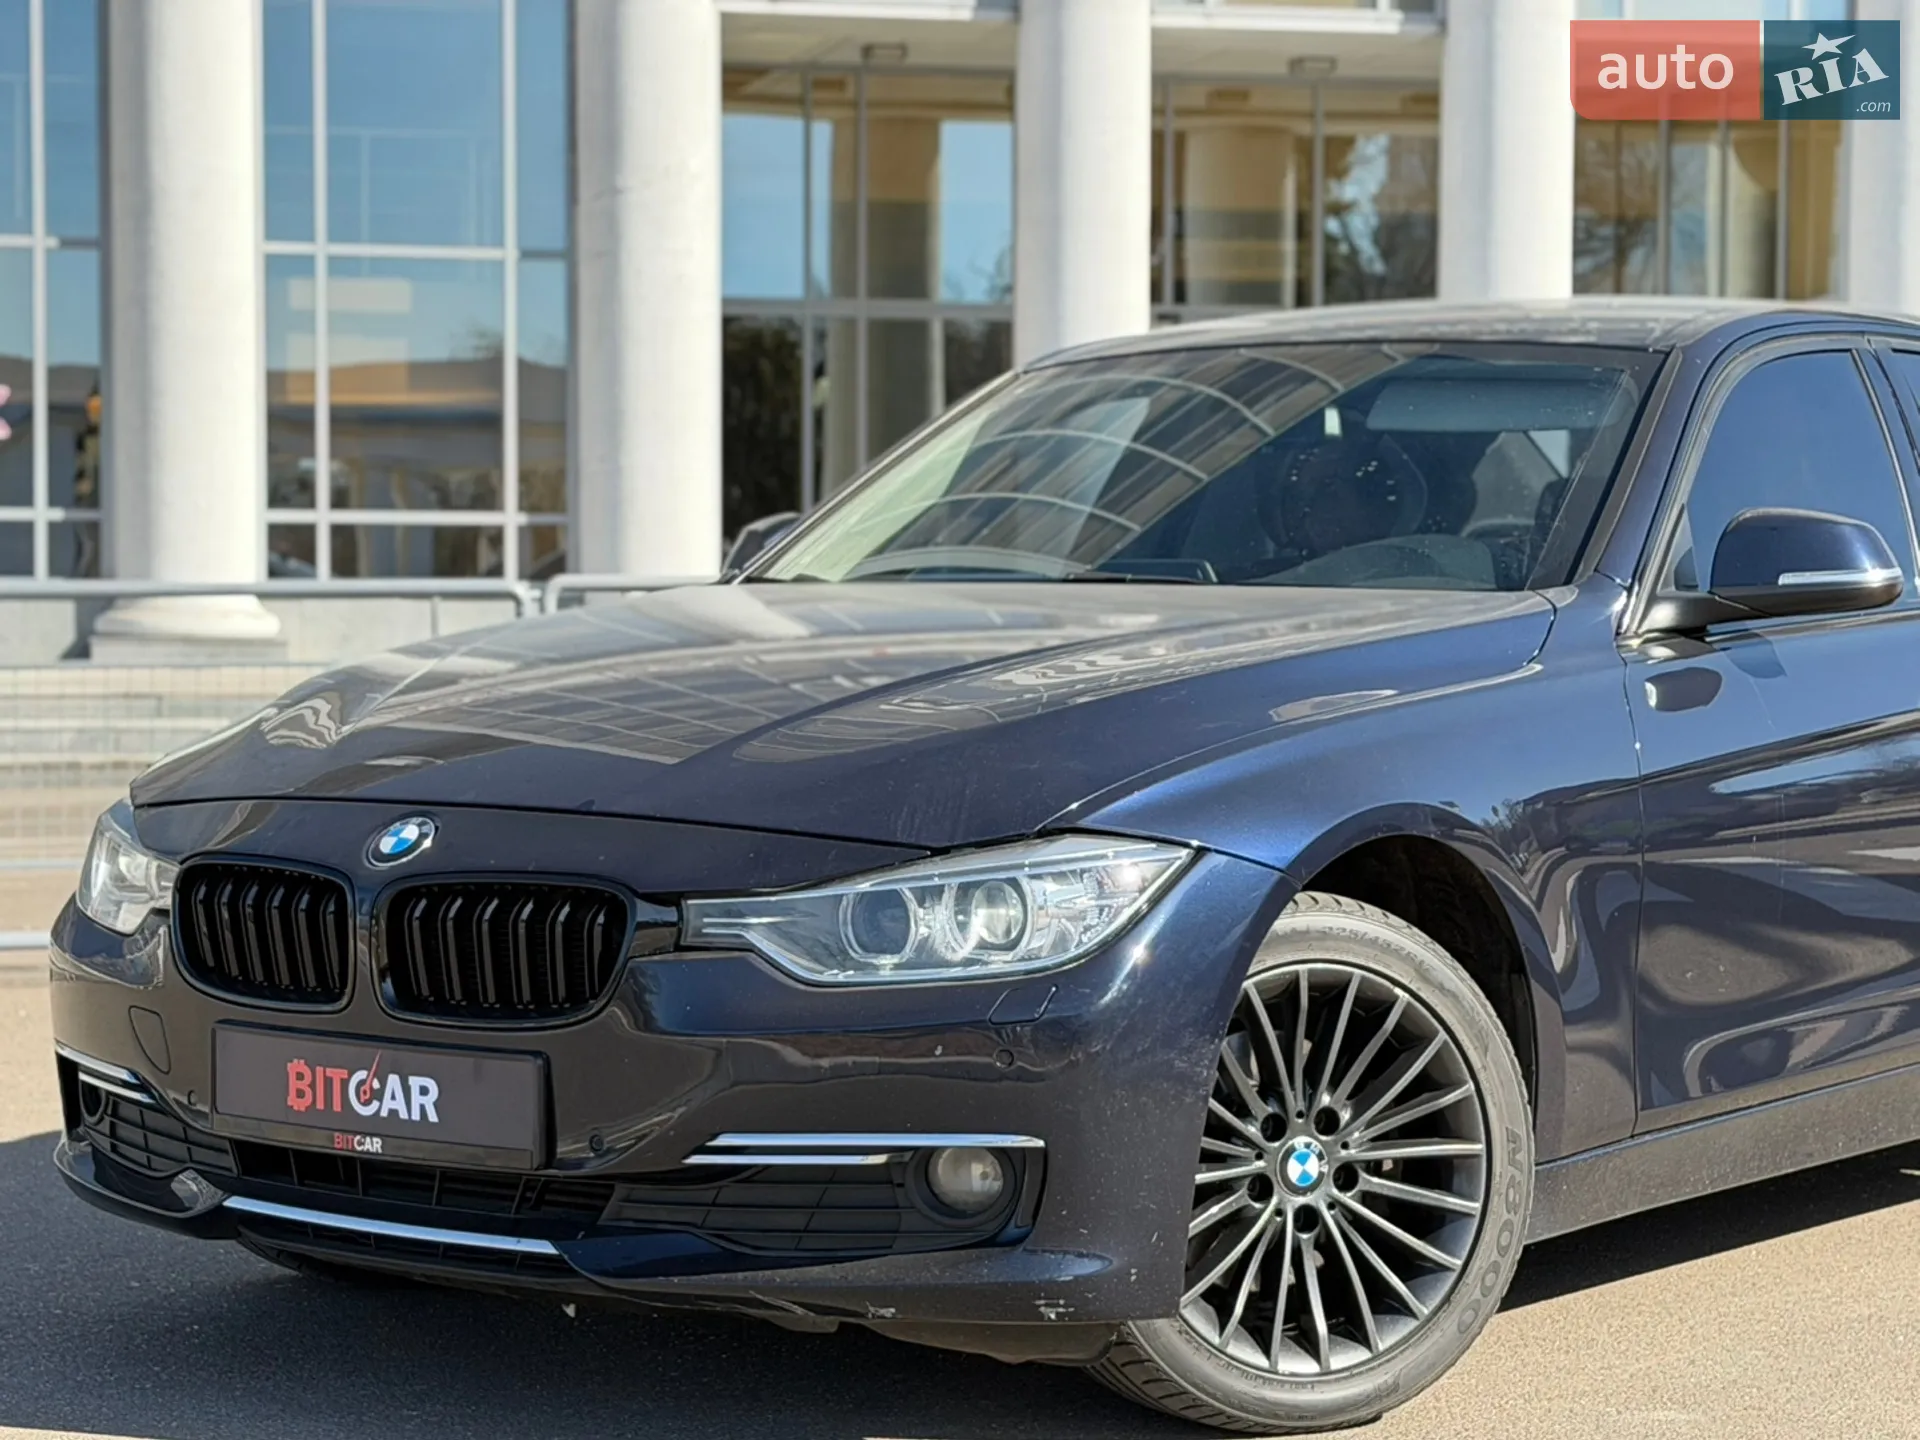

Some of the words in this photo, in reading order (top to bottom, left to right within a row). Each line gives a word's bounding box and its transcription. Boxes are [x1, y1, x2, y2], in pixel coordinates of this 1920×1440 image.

[286, 1058, 440, 1123] BITCAR
[333, 1132, 383, 1154] BITCAR
[1457, 1126, 1524, 1335] N8000
